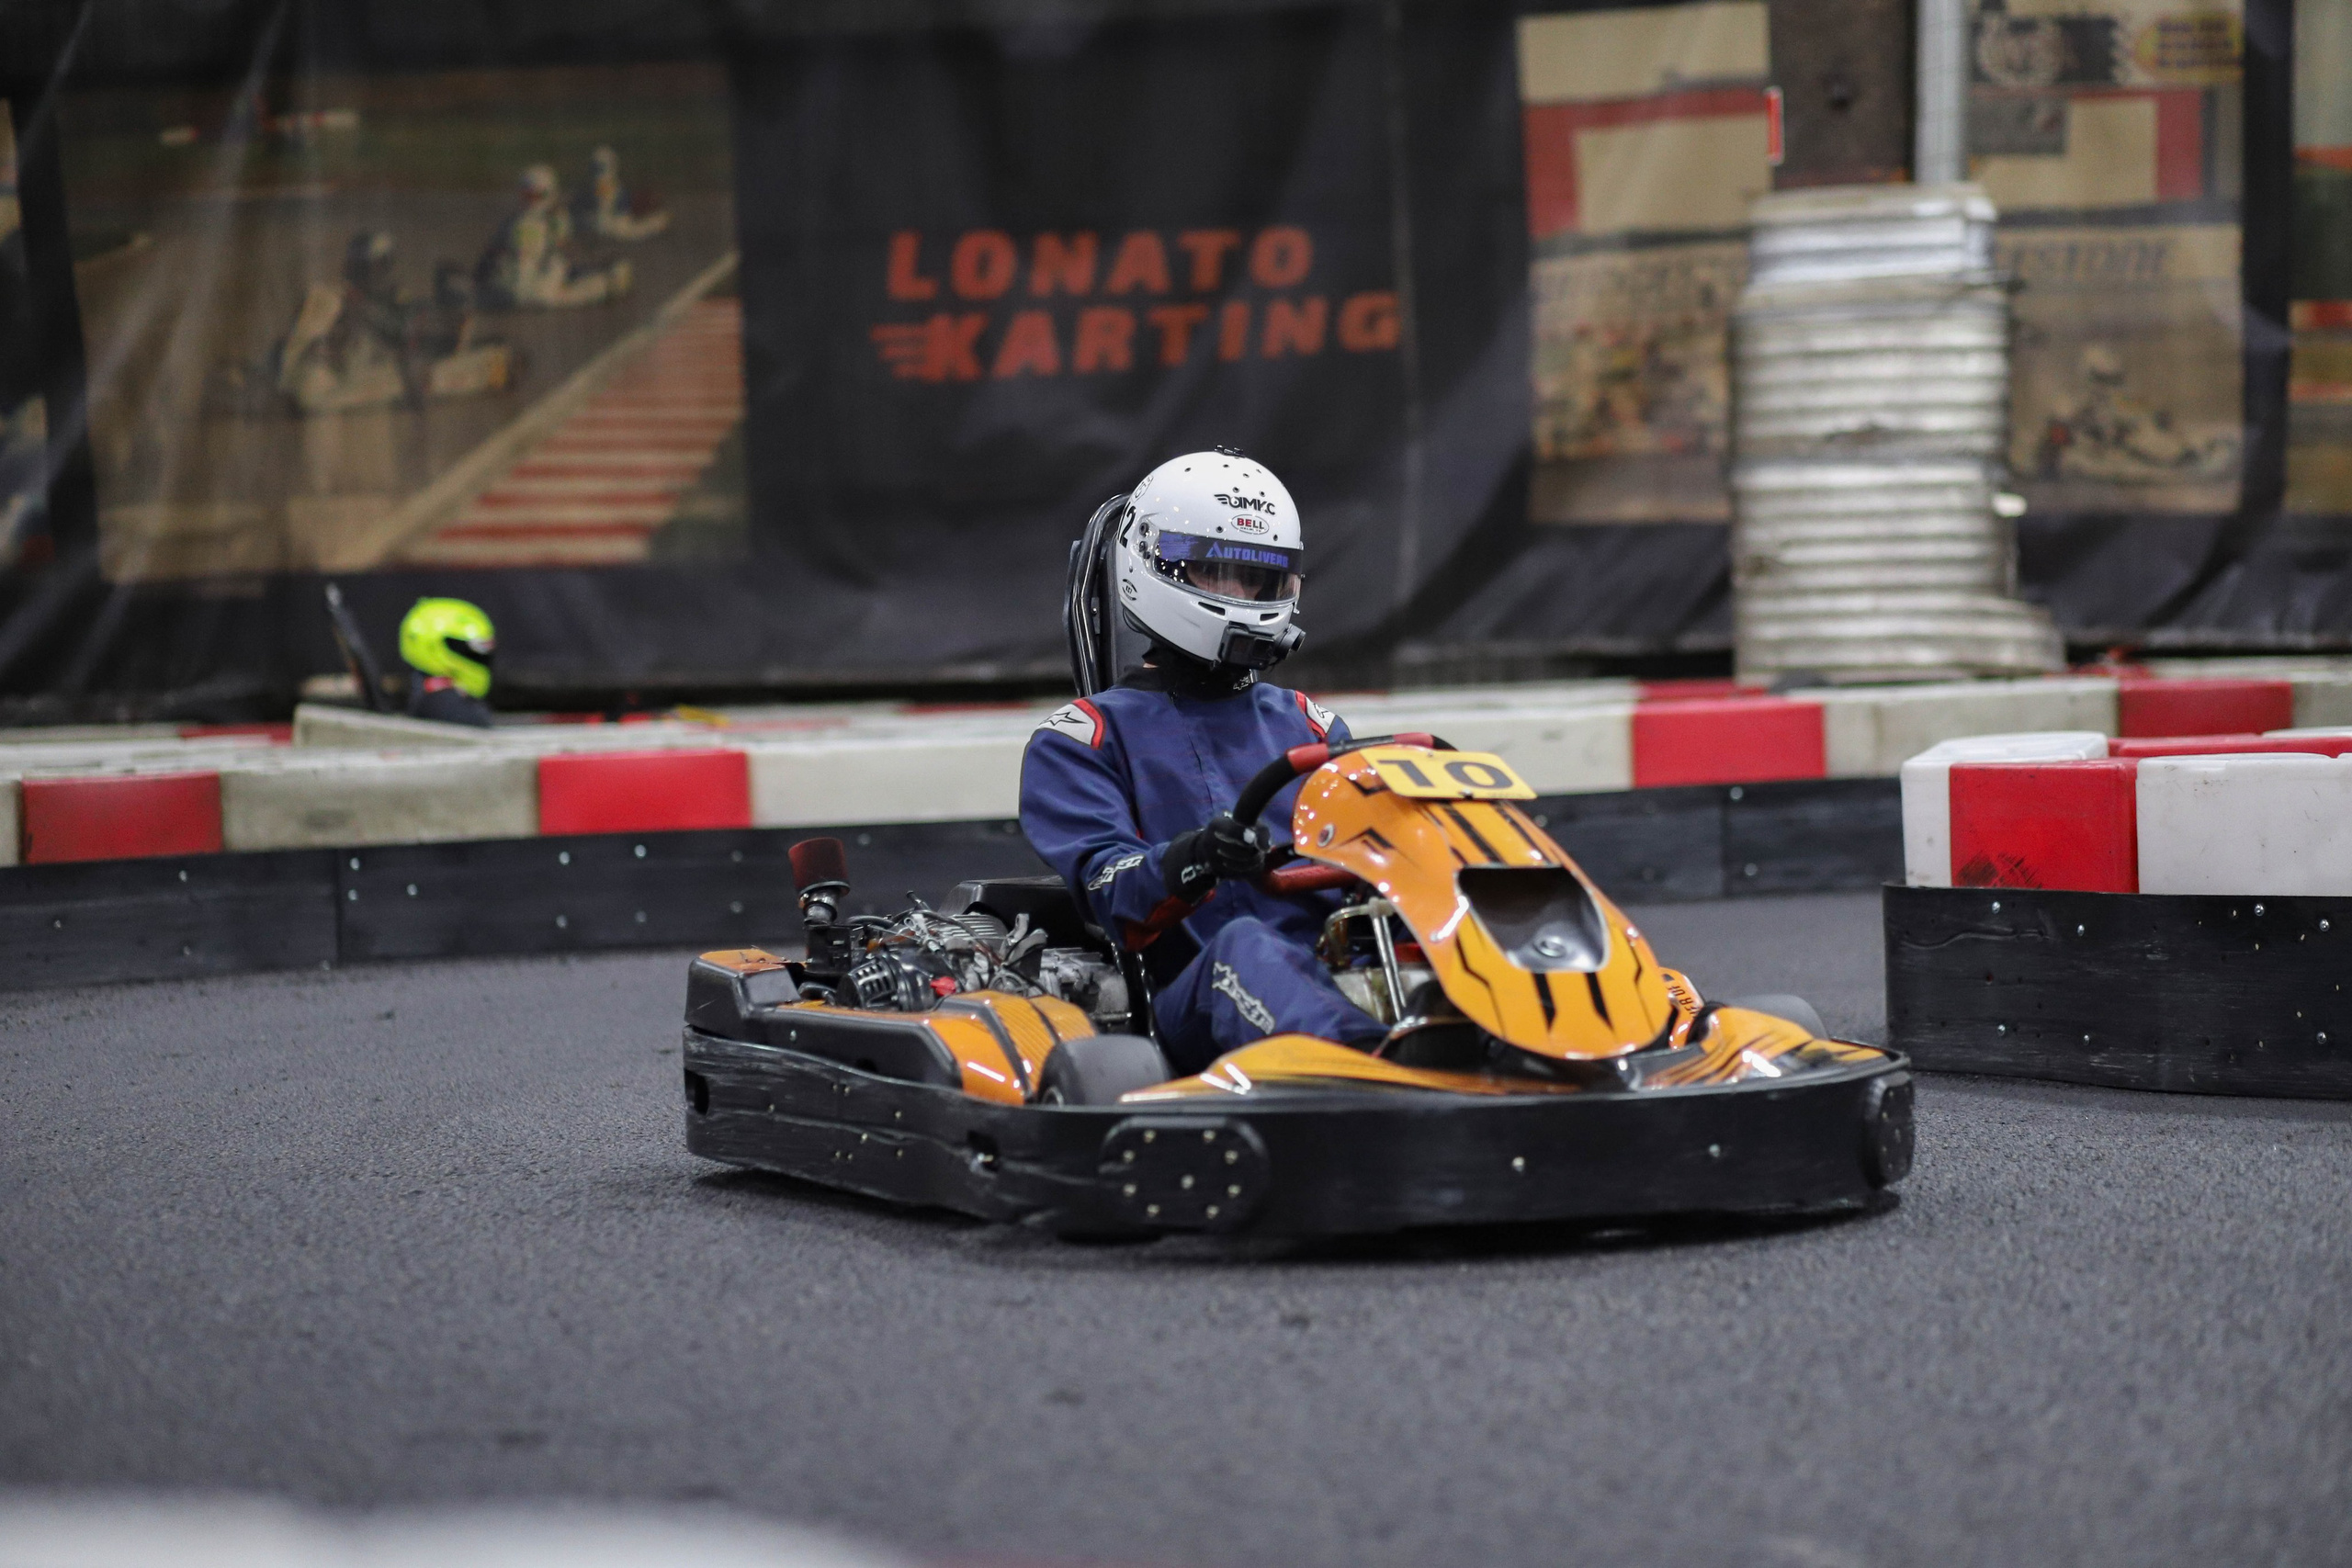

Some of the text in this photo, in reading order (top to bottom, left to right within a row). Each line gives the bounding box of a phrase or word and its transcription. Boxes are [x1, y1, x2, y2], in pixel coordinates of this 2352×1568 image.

[887, 226, 1314, 300] LONATO
[919, 291, 1401, 382] KARTING
[1237, 517, 1265, 530] BELL
[1378, 760, 1514, 789] 10
